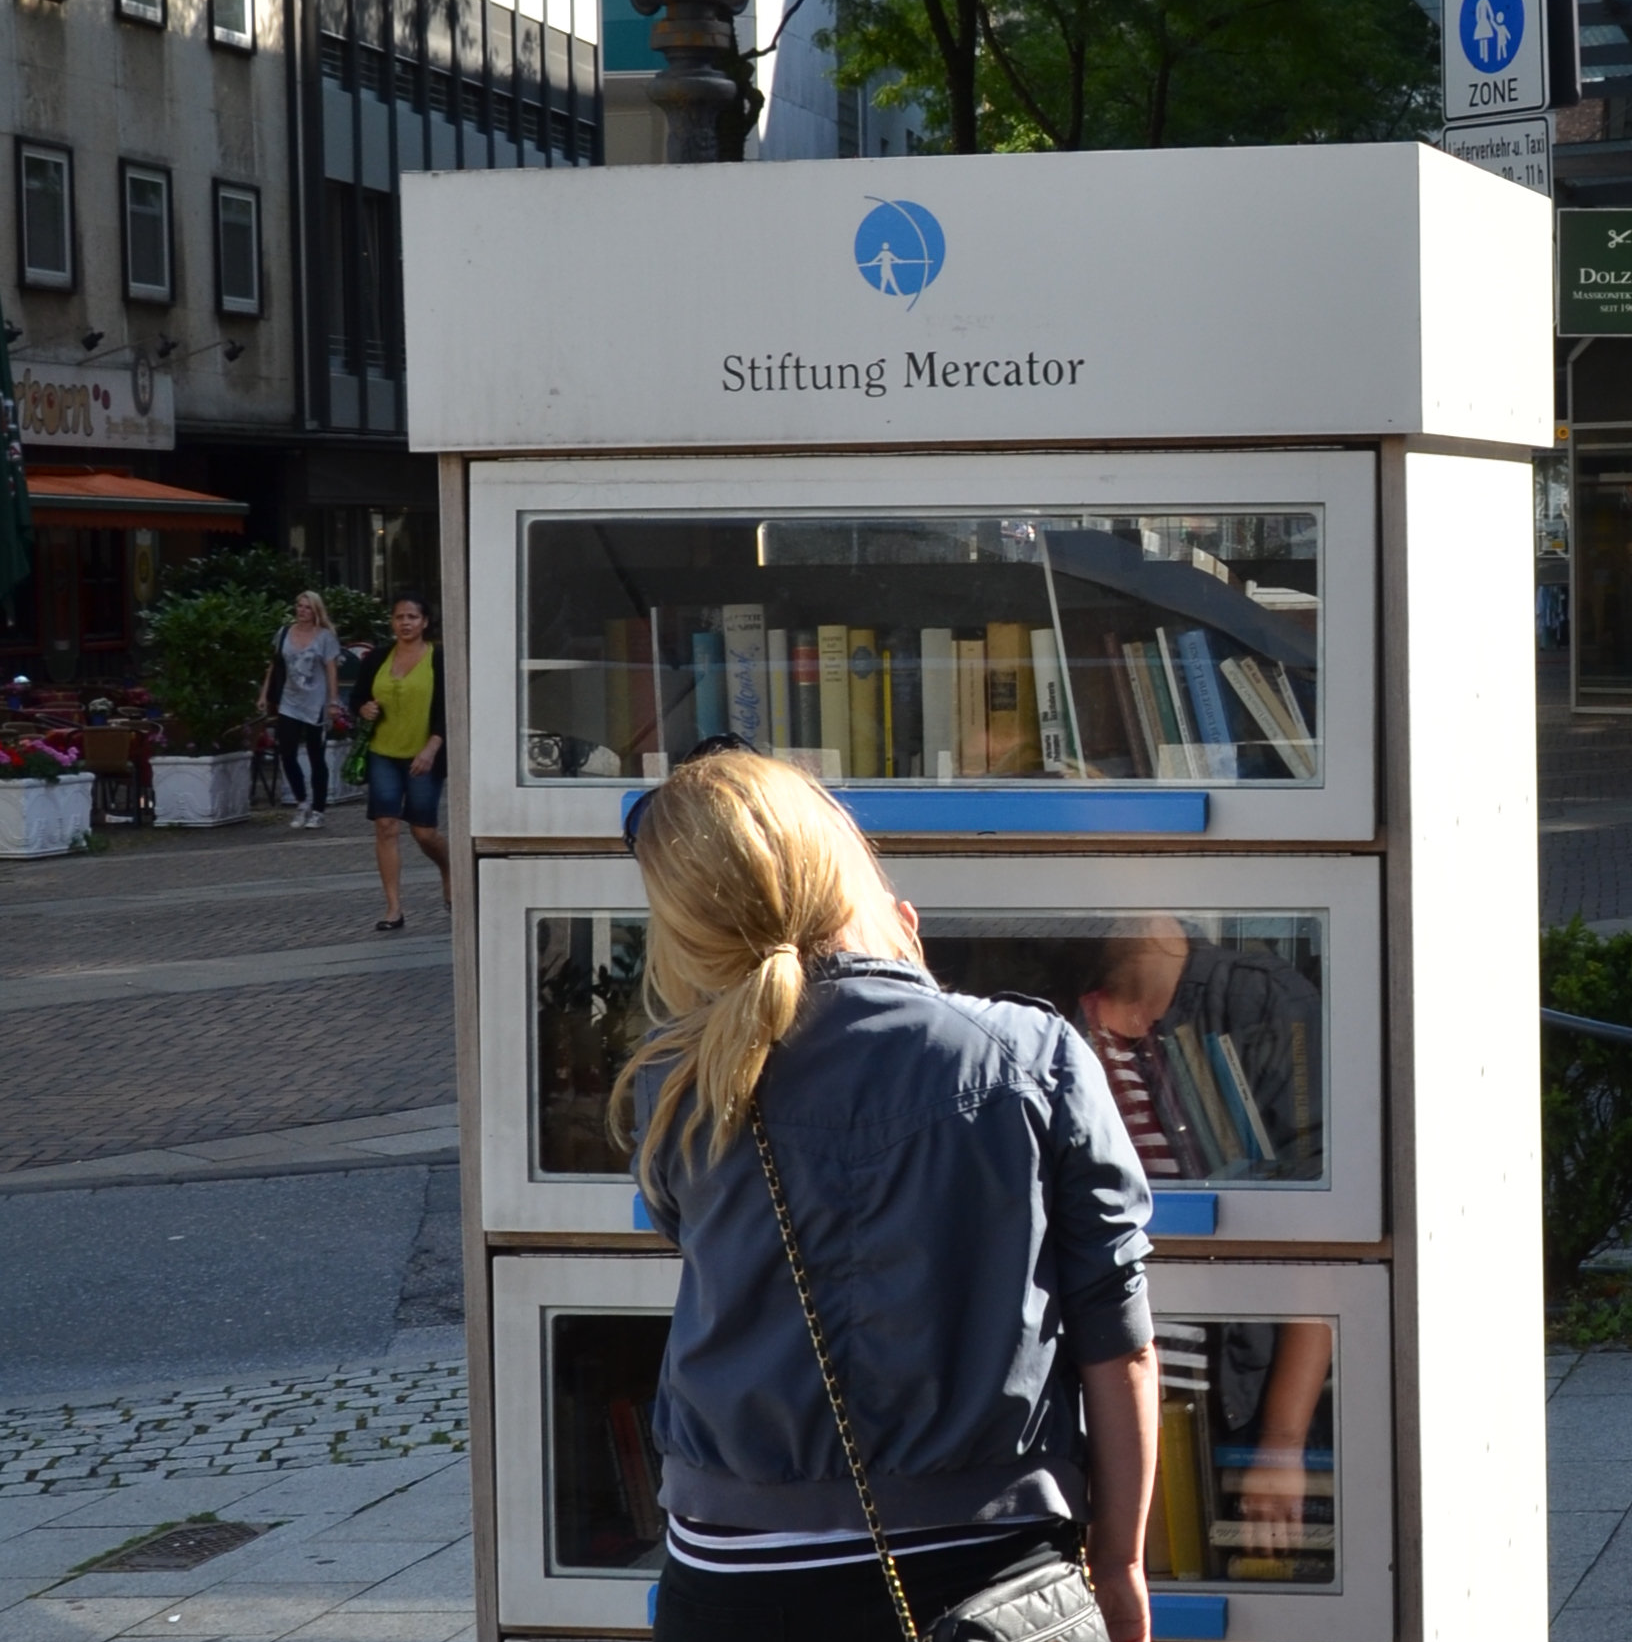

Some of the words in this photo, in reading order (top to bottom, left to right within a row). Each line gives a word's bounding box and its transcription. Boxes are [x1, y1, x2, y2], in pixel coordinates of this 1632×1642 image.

[1468, 77, 1519, 108] ZONE
[1525, 132, 1545, 155] Taxi
[1525, 164, 1535, 185] 11
[1537, 164, 1544, 184] h
[721, 352, 888, 397] Stiftung
[904, 350, 1086, 390] Mercator
